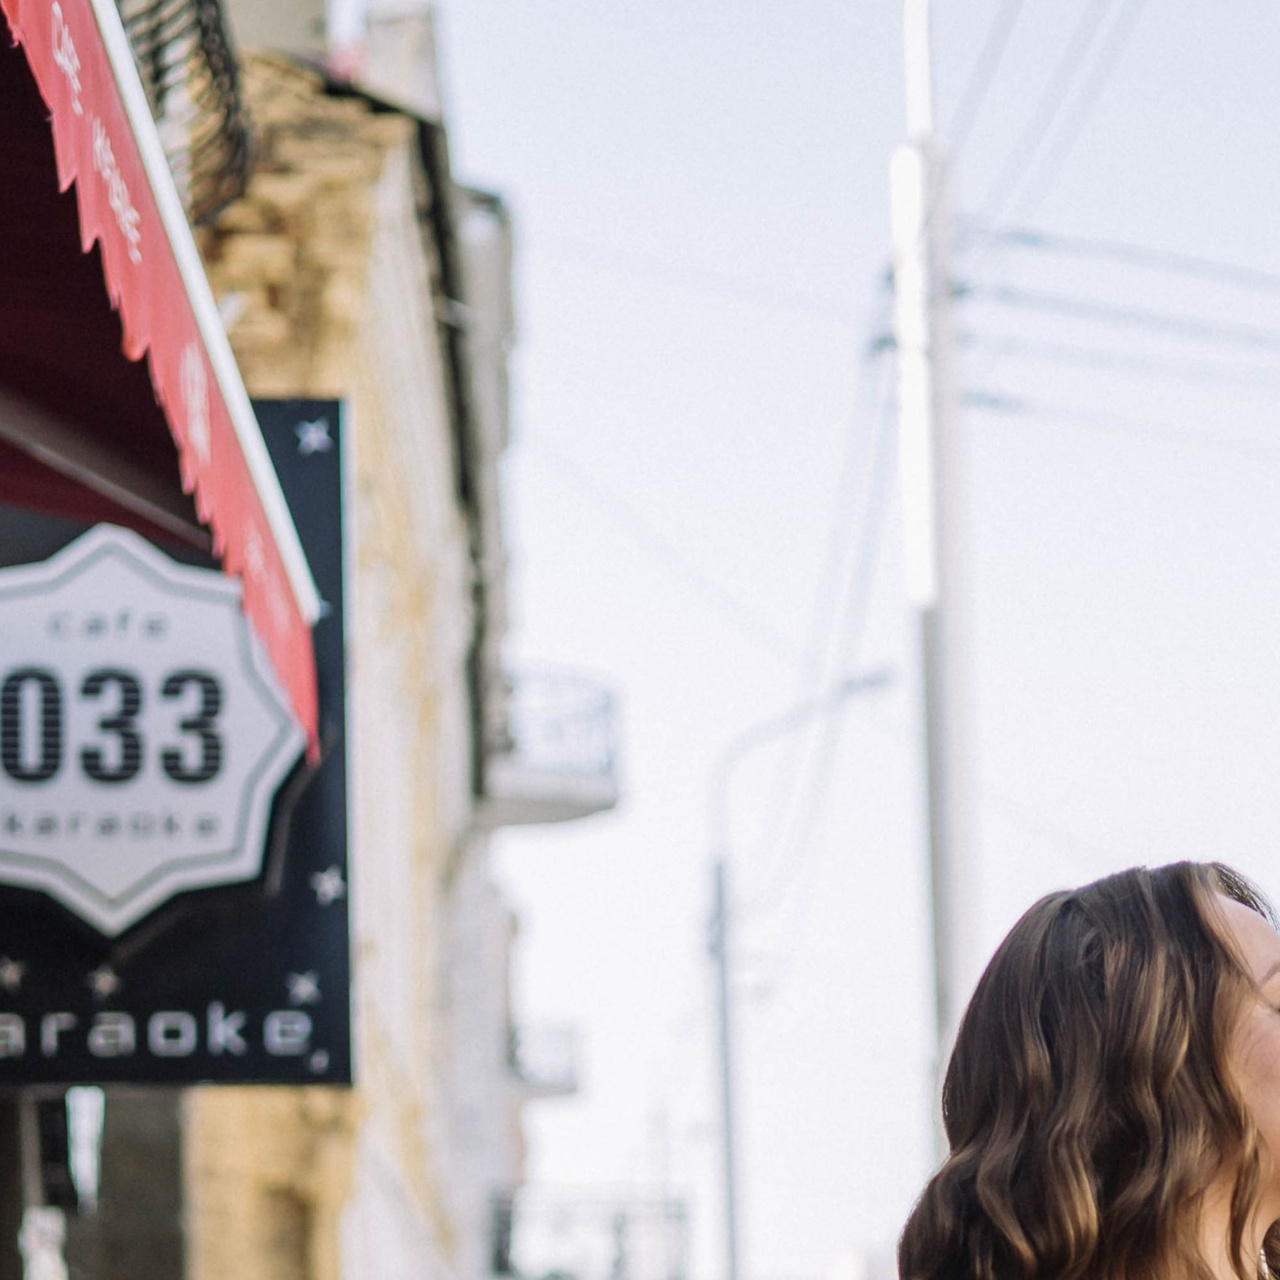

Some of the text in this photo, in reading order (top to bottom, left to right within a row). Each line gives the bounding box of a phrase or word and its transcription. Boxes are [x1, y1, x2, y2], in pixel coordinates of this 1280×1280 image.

[47, 606, 168, 641] cafe
[0, 666, 223, 785] 033
[4, 810, 219, 841] karaoke
